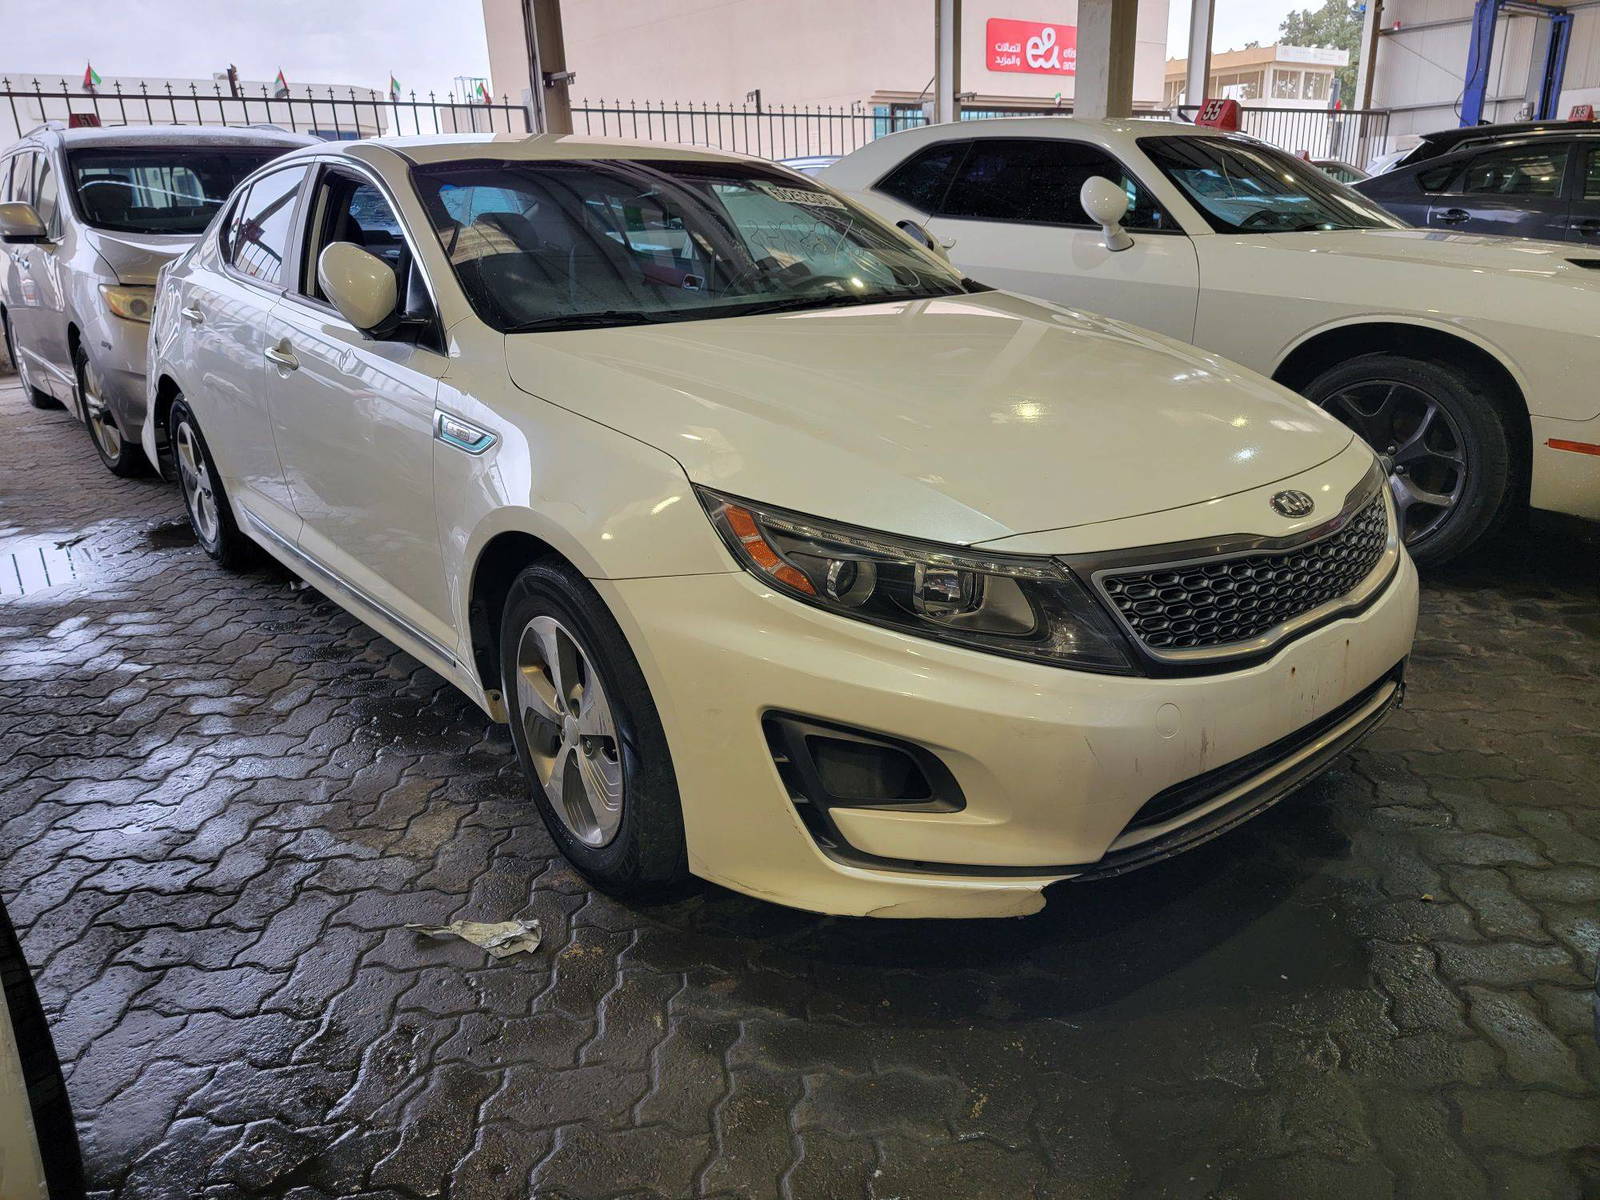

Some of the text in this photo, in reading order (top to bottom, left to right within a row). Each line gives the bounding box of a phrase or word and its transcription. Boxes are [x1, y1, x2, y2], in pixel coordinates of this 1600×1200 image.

[995, 42, 1021, 53] اتصالات
[995, 55, 1021, 67] والمزيد
[1202, 101, 1225, 120] 55
